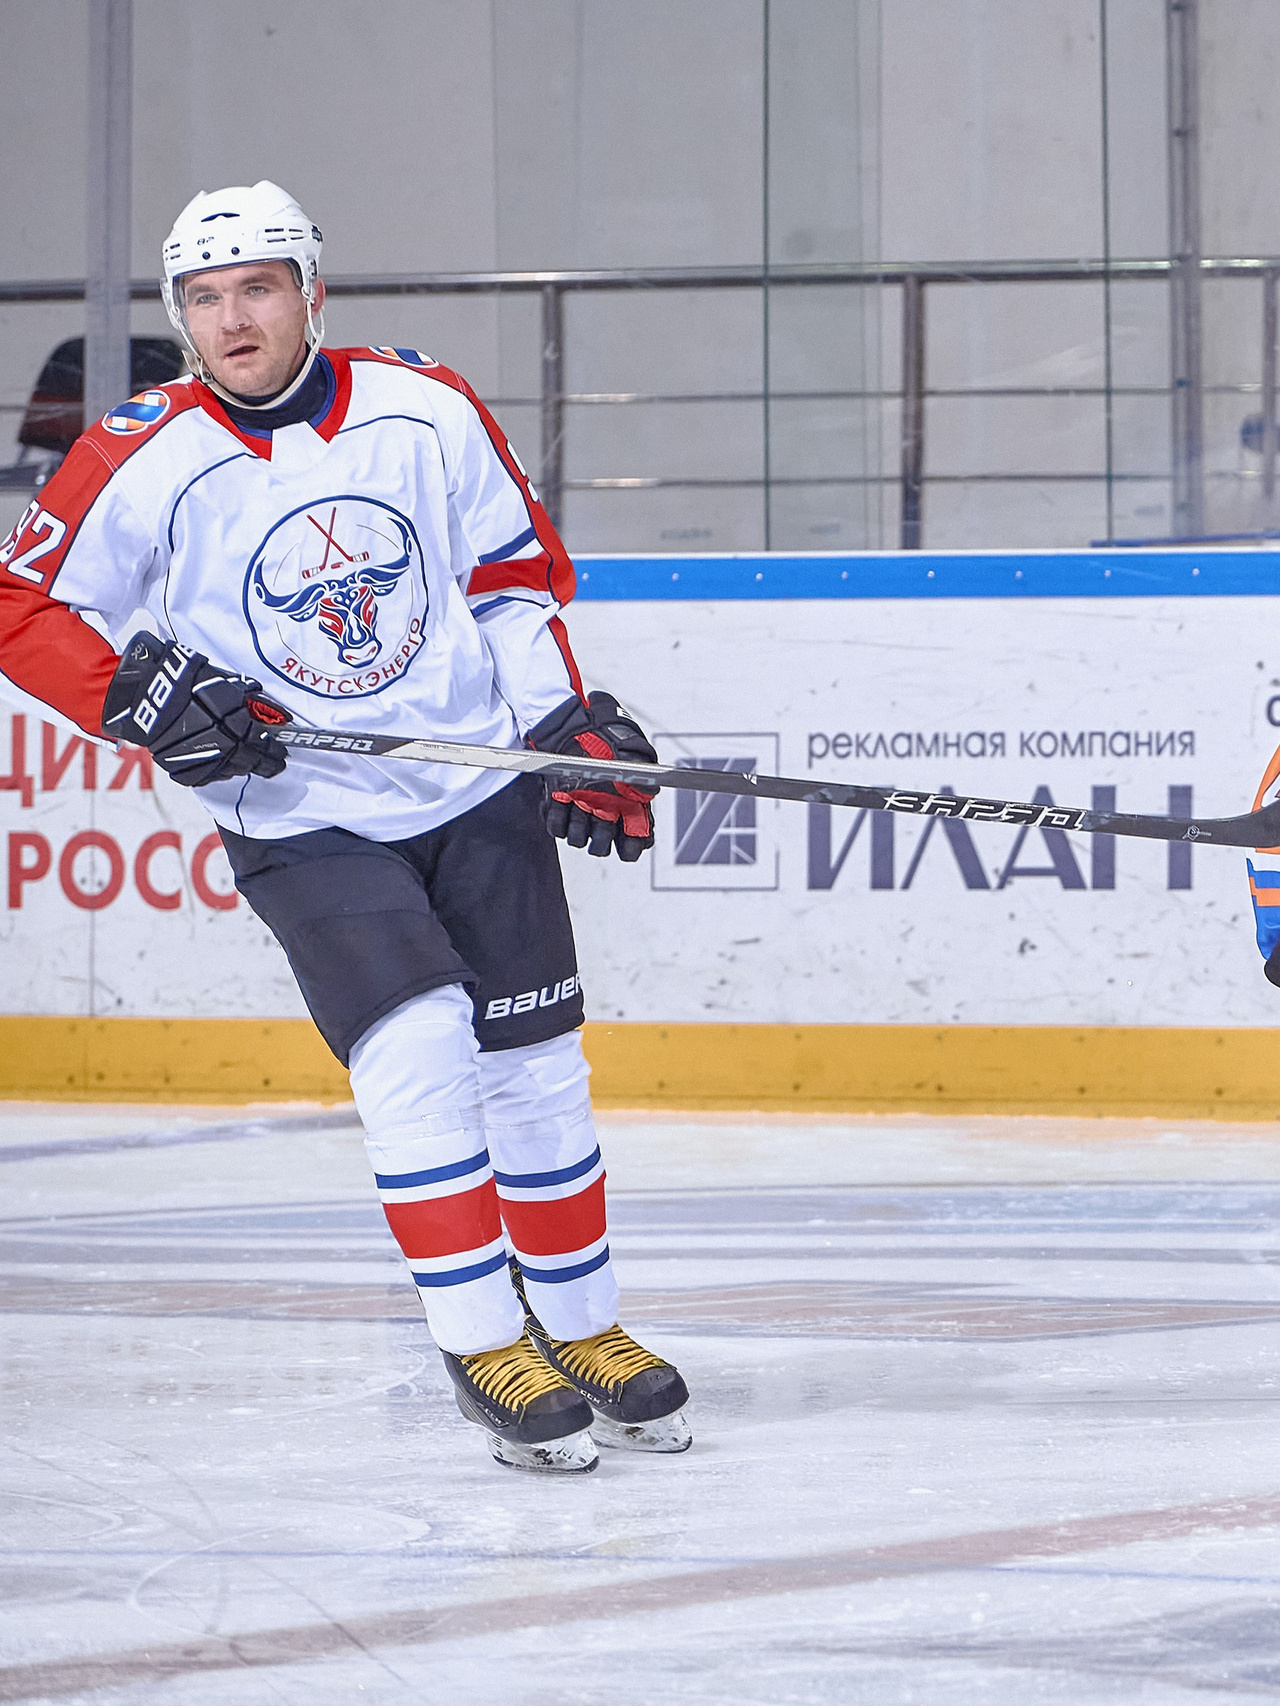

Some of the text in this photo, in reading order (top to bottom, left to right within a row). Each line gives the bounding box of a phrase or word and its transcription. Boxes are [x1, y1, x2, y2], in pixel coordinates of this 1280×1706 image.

[280, 617, 421, 694] ЯКУТСКЭНЕРГО
[808, 730, 1196, 769] рекламная компания
[7, 829, 239, 911] РОСС
[806, 784, 1195, 891] ИЛАН
